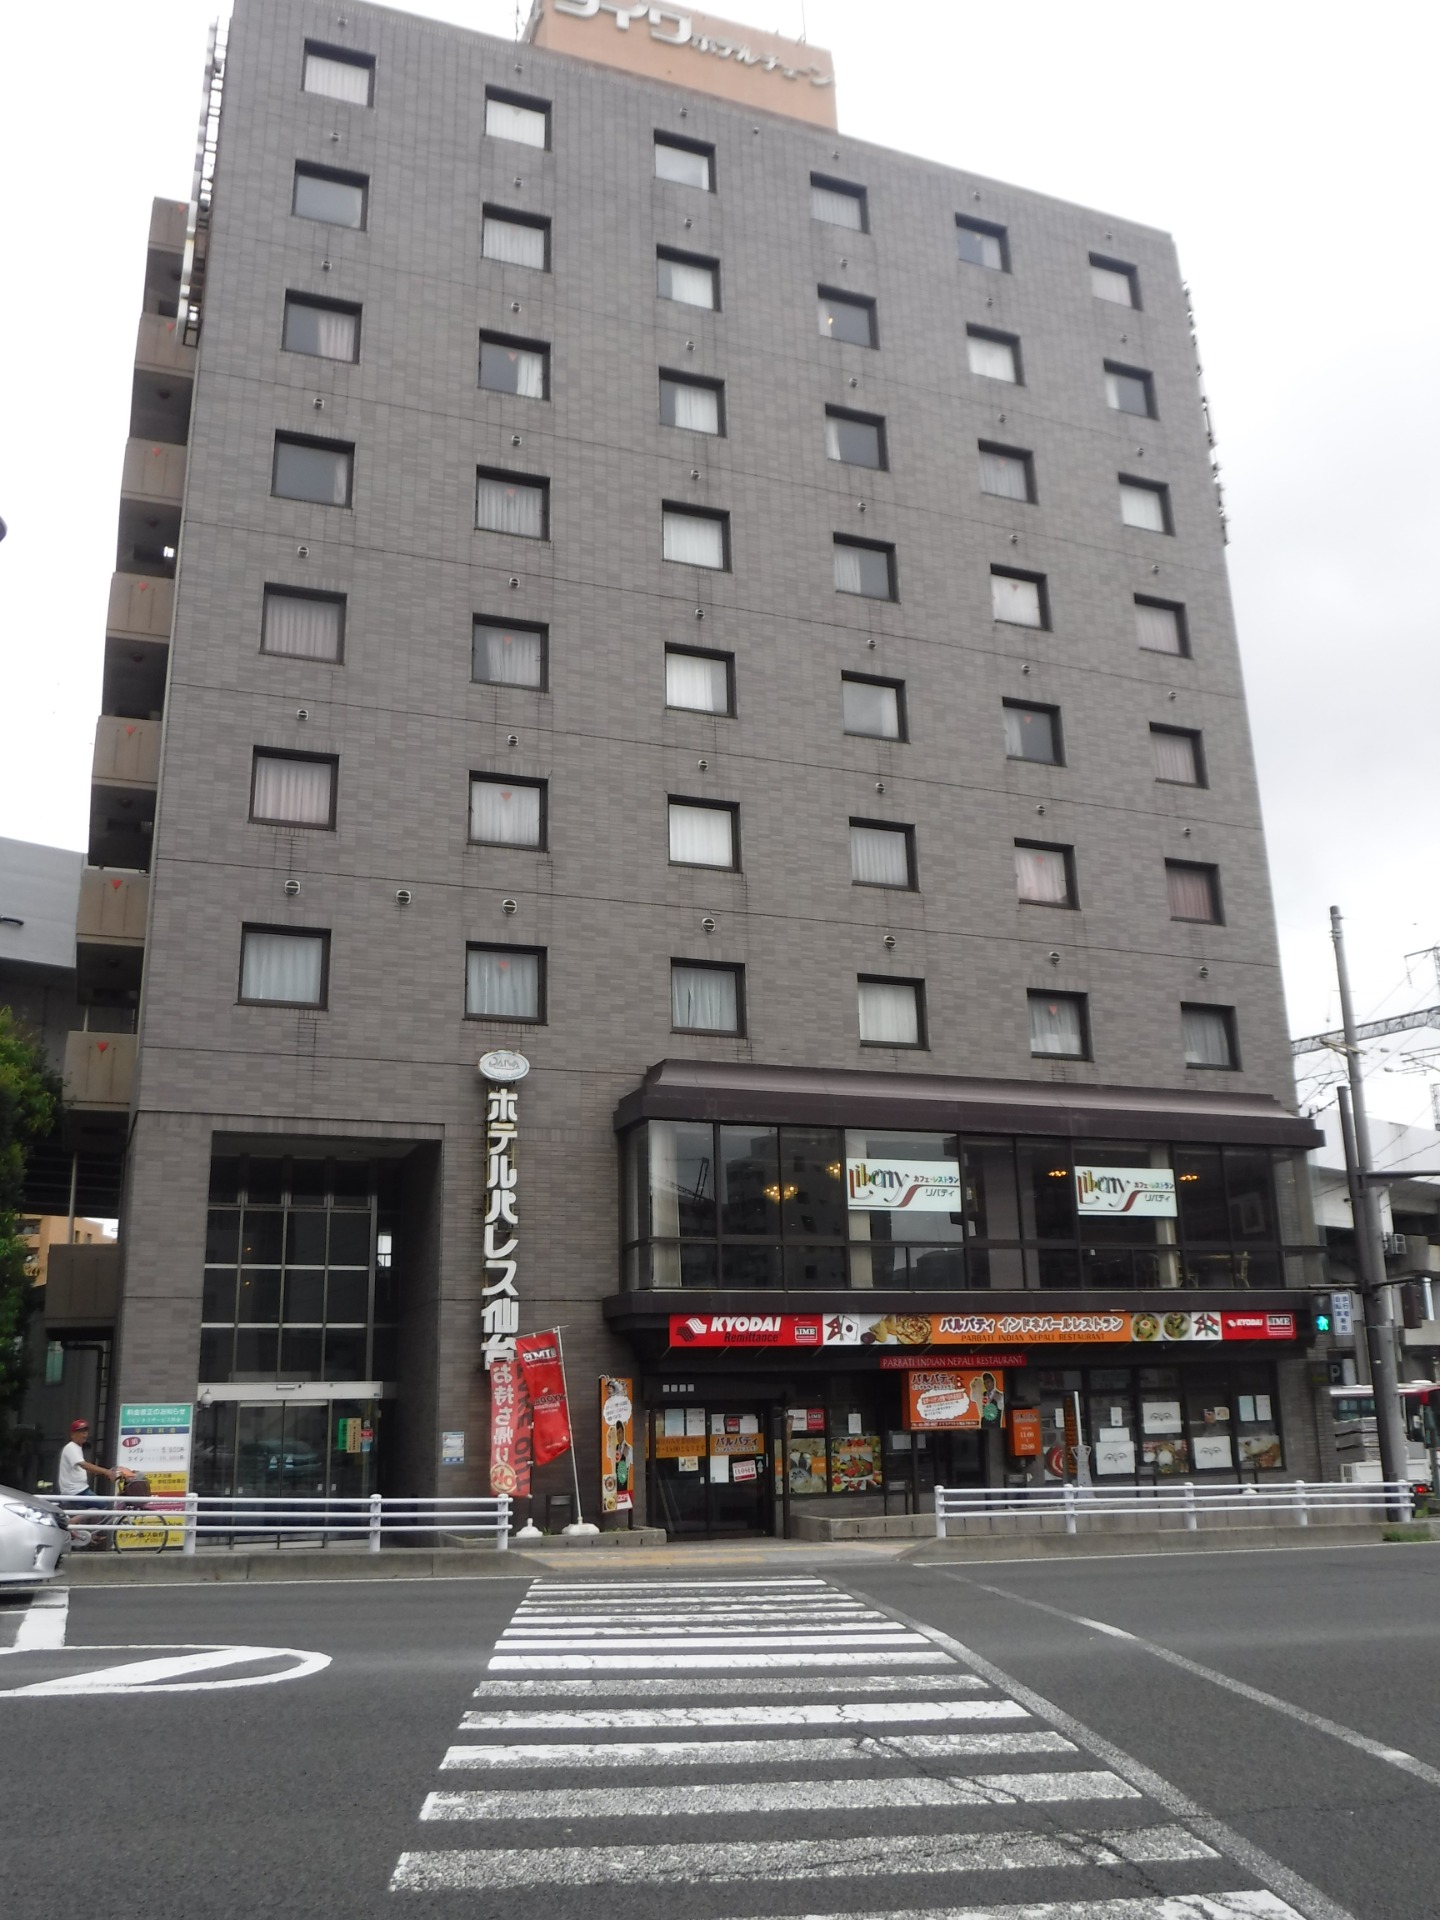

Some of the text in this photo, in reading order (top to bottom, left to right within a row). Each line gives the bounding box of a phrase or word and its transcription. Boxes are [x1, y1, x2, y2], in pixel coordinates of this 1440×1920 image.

[481, 1088, 519, 1371] ホテルパレス仙台
[710, 1316, 782, 1332] KYODAI
[961, 1334, 995, 1342] PARBATI
[1058, 1333, 1105, 1341] RESTAURANT
[882, 1355, 1023, 1367] PARBATI INDIAN NEPALI RESTAURANT
